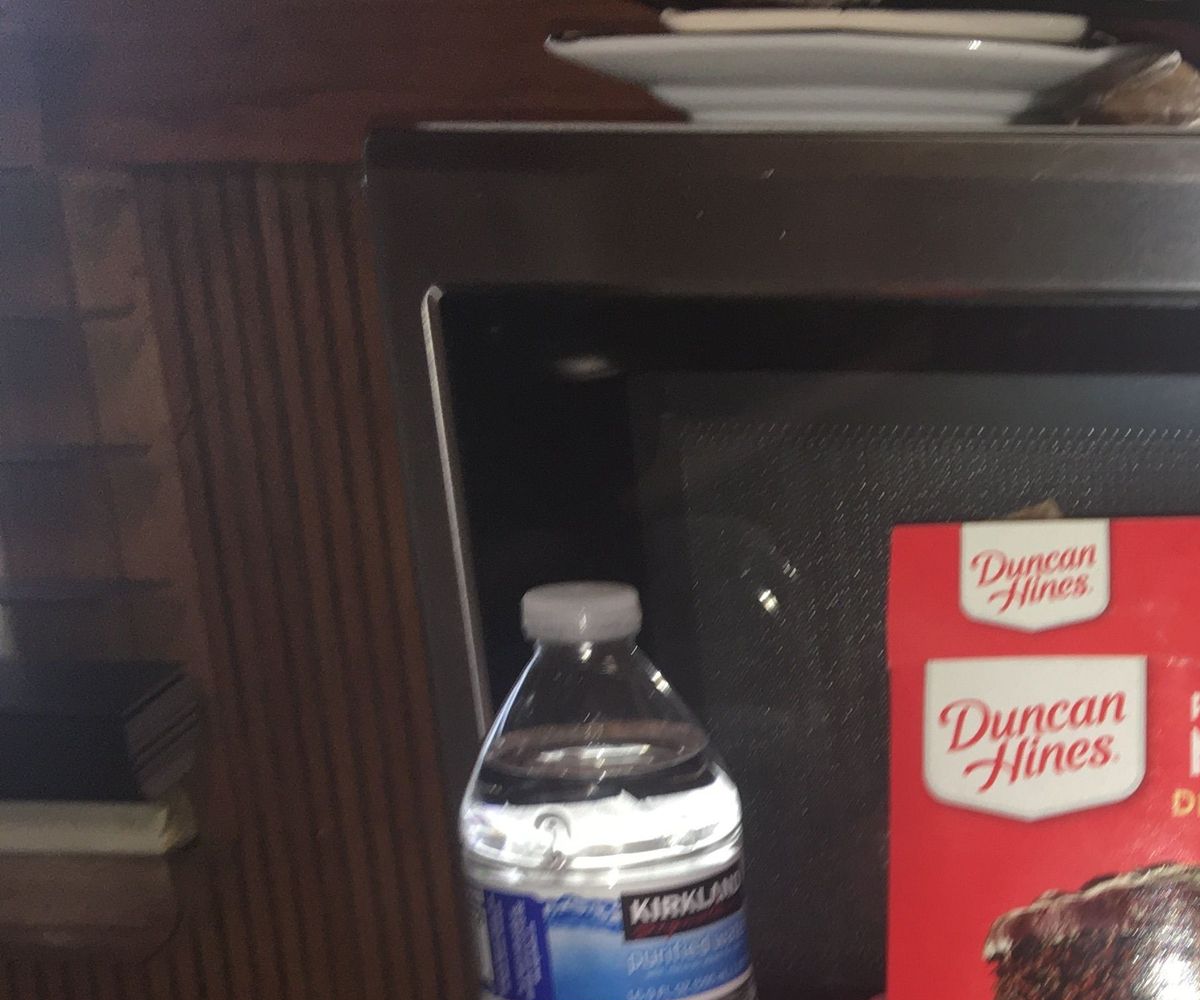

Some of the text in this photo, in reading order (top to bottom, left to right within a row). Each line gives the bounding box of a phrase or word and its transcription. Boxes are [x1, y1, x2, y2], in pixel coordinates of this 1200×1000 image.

[970, 543, 1098, 587] Duncan
[988, 573, 1090, 614] Hines
[938, 690, 1127, 753] Duncan
[962, 733, 1115, 793] Hines
